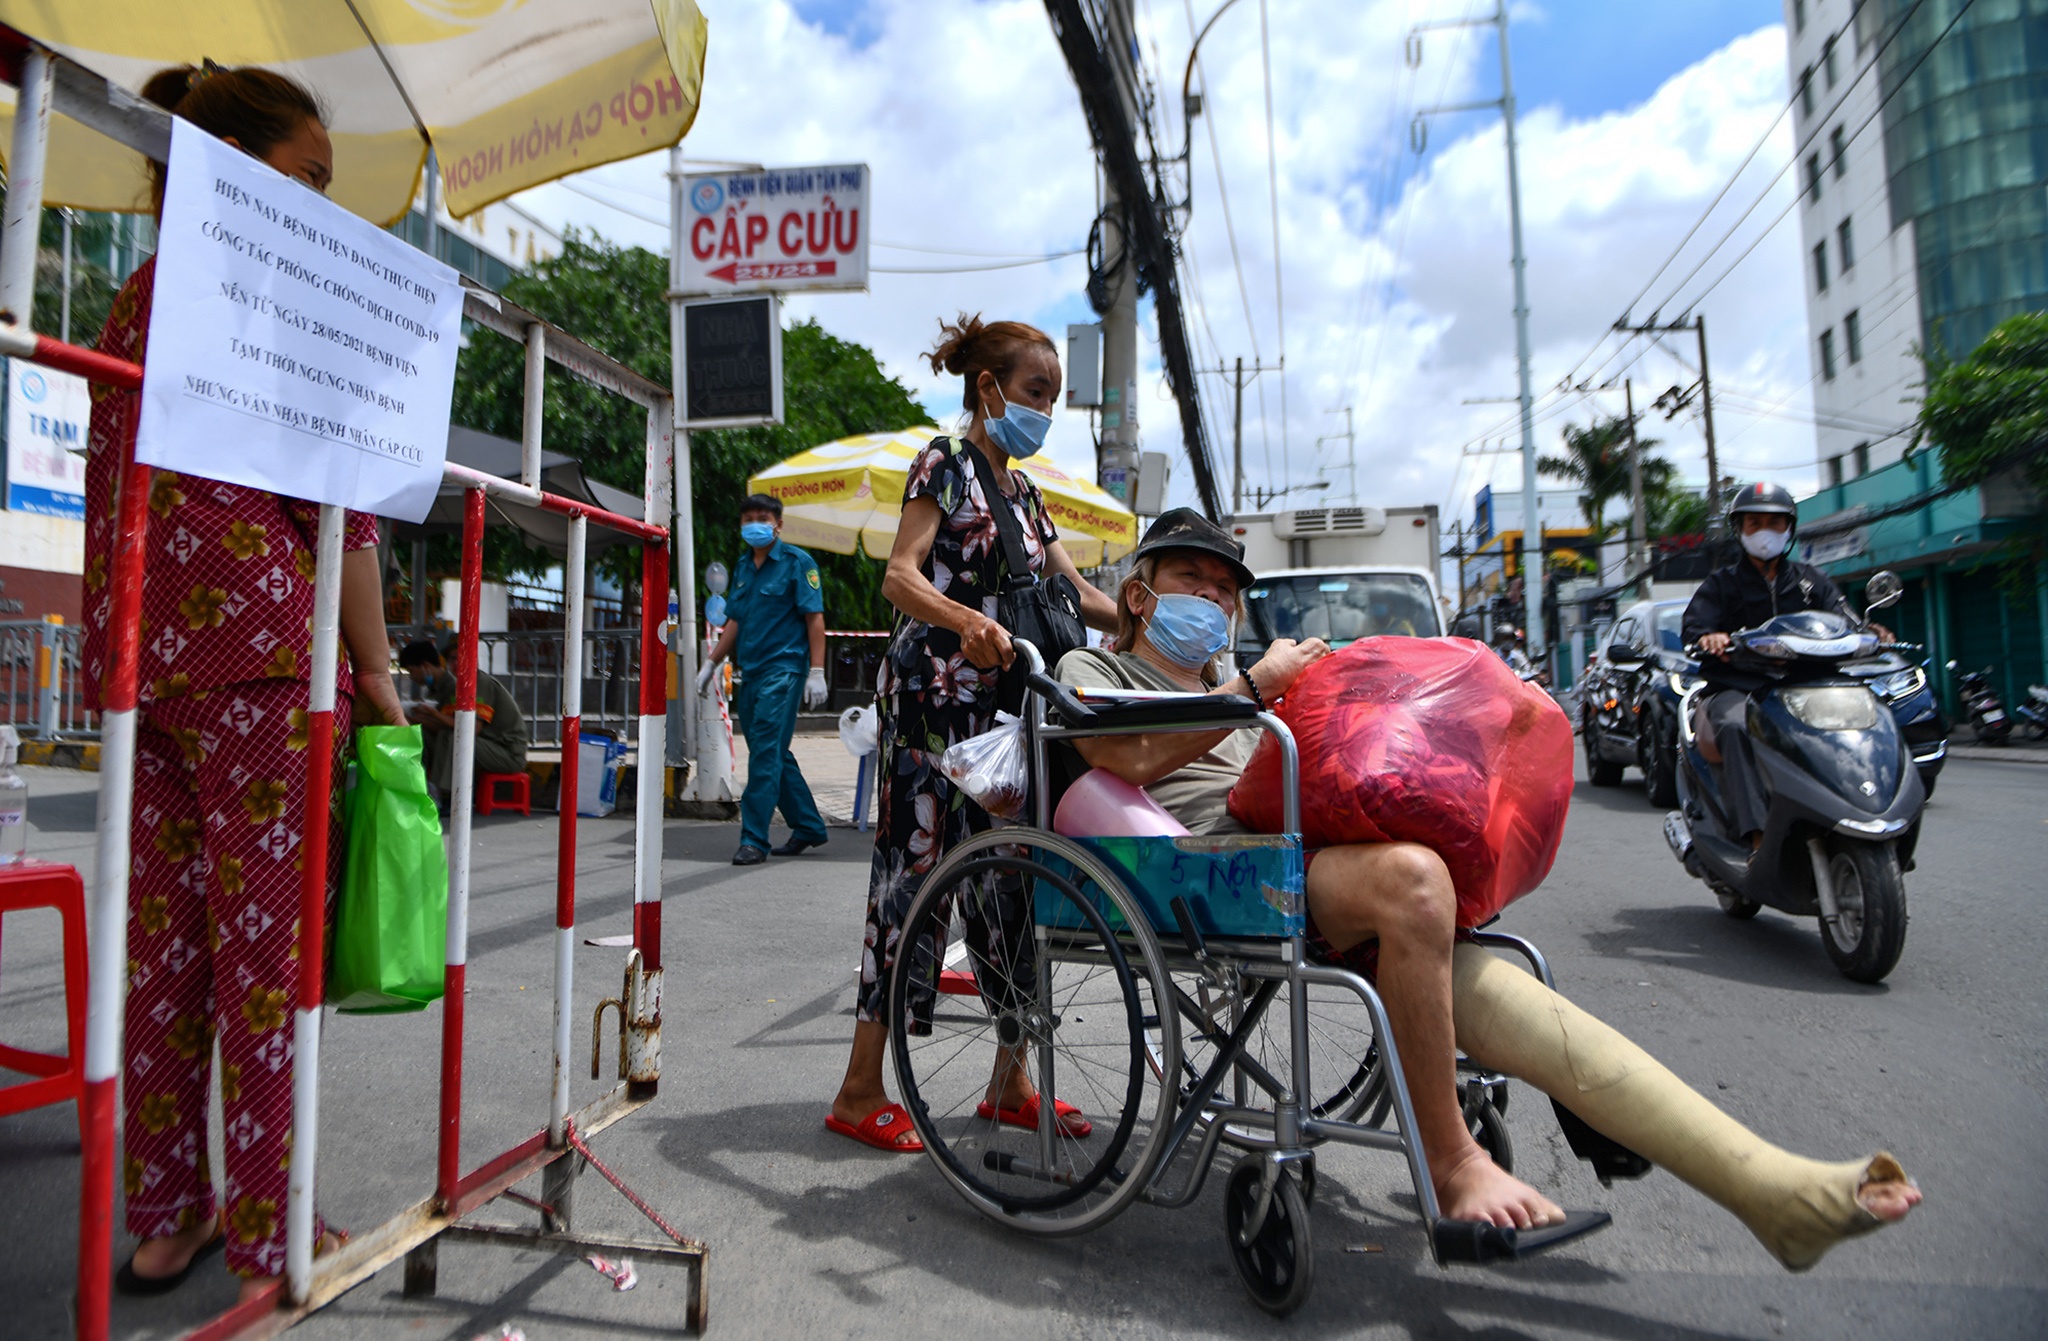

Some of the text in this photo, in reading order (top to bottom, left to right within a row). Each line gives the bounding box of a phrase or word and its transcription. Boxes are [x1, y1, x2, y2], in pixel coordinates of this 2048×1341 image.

[728, 174, 756, 198] BỆNH
[760, 171, 782, 199] VIỆN
[785, 170, 813, 199] QUẬN
[215, 178, 437, 305] HIỆN NAY BỆNH VIỆN ĐANG THỰC HIỆN
[691, 199, 769, 262] CẤP
[201, 221, 439, 344] CÔNG TÁC PHÒNG CHỐNG DỊCH COVID-19
[735, 263, 819, 279] 24/24
[273, 305, 310, 331] NGÀY
[312, 321, 363, 353] 28/05/2021
[366, 344, 393, 367] BỆNH
[395, 357, 418, 377] VIỆN
[230, 337, 405, 415] TẠM THỜI NGƯNG NHẬN BỆNH
[183, 375, 238, 405] NHƯNG
[311, 415, 346, 438] BỆNH
[401, 445, 424, 463] CỨU
[1102, 519, 1127, 535] NGON
[1170, 854, 1192, 884] 5
